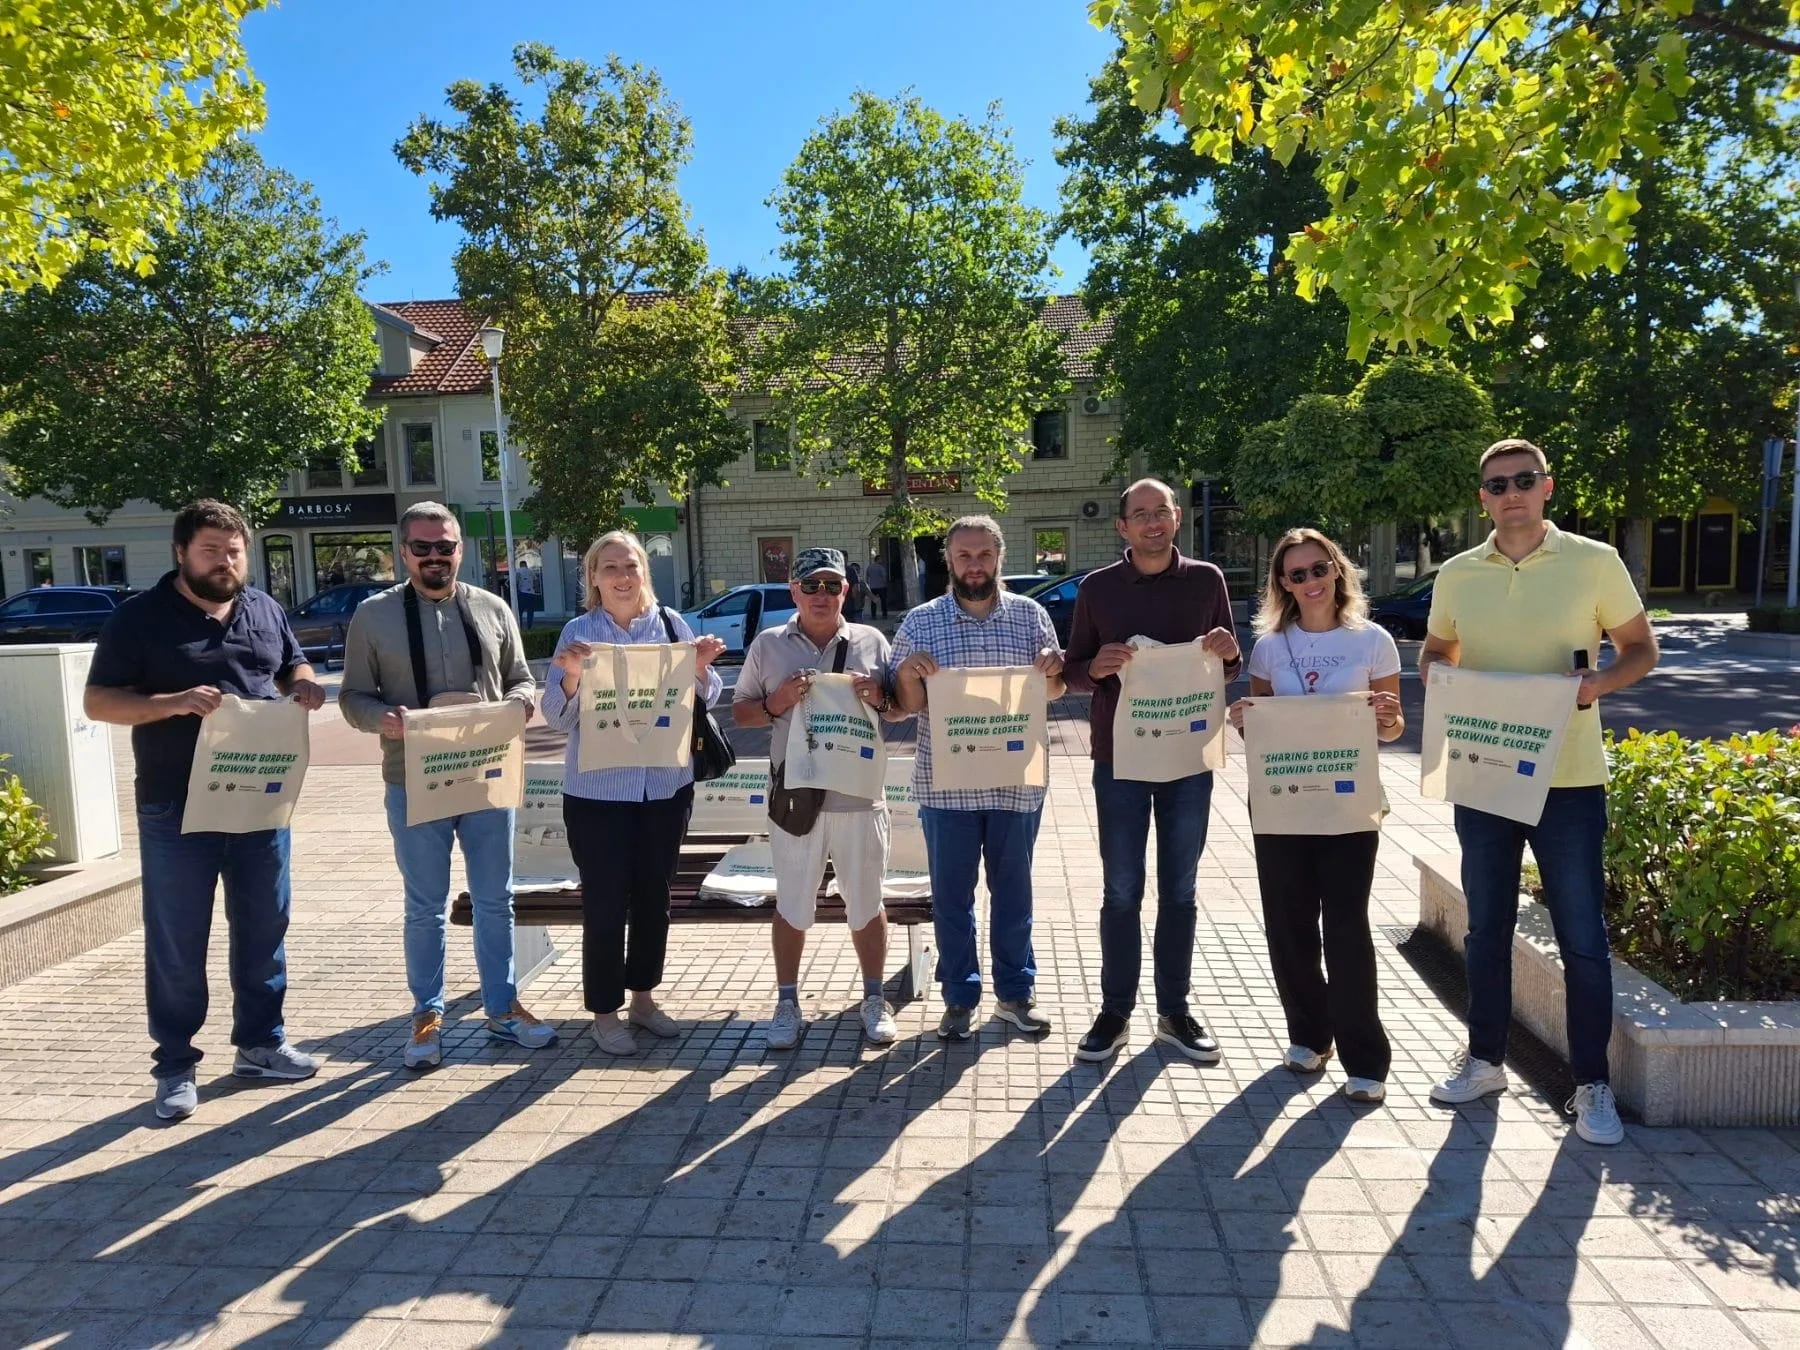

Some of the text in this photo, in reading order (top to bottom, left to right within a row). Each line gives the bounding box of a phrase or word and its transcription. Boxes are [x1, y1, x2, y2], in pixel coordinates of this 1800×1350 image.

[288, 503, 352, 514] BARBOSA
[637, 688, 679, 697] BORRS
[595, 700, 676, 711] GROG CLR"
[944, 713, 1030, 726] "SHARING BORDERS
[1131, 710, 1176, 719] GROWING
[848, 716, 875, 730] BORDER
[1444, 714, 1552, 739] "SHARING BORDERS
[947, 727, 990, 737] GROWING
[1446, 729, 1546, 754] GROWING CLOSER"
[469, 743, 511, 759] BORDERS
[1312, 749, 1360, 760] BORDERS
[259, 753, 298, 763] BORDERS
[210, 764, 292, 775] GROWING CLOSER"
[424, 753, 508, 775] GROWING CLOSER"
[1265, 765, 1313, 776] GROWING
